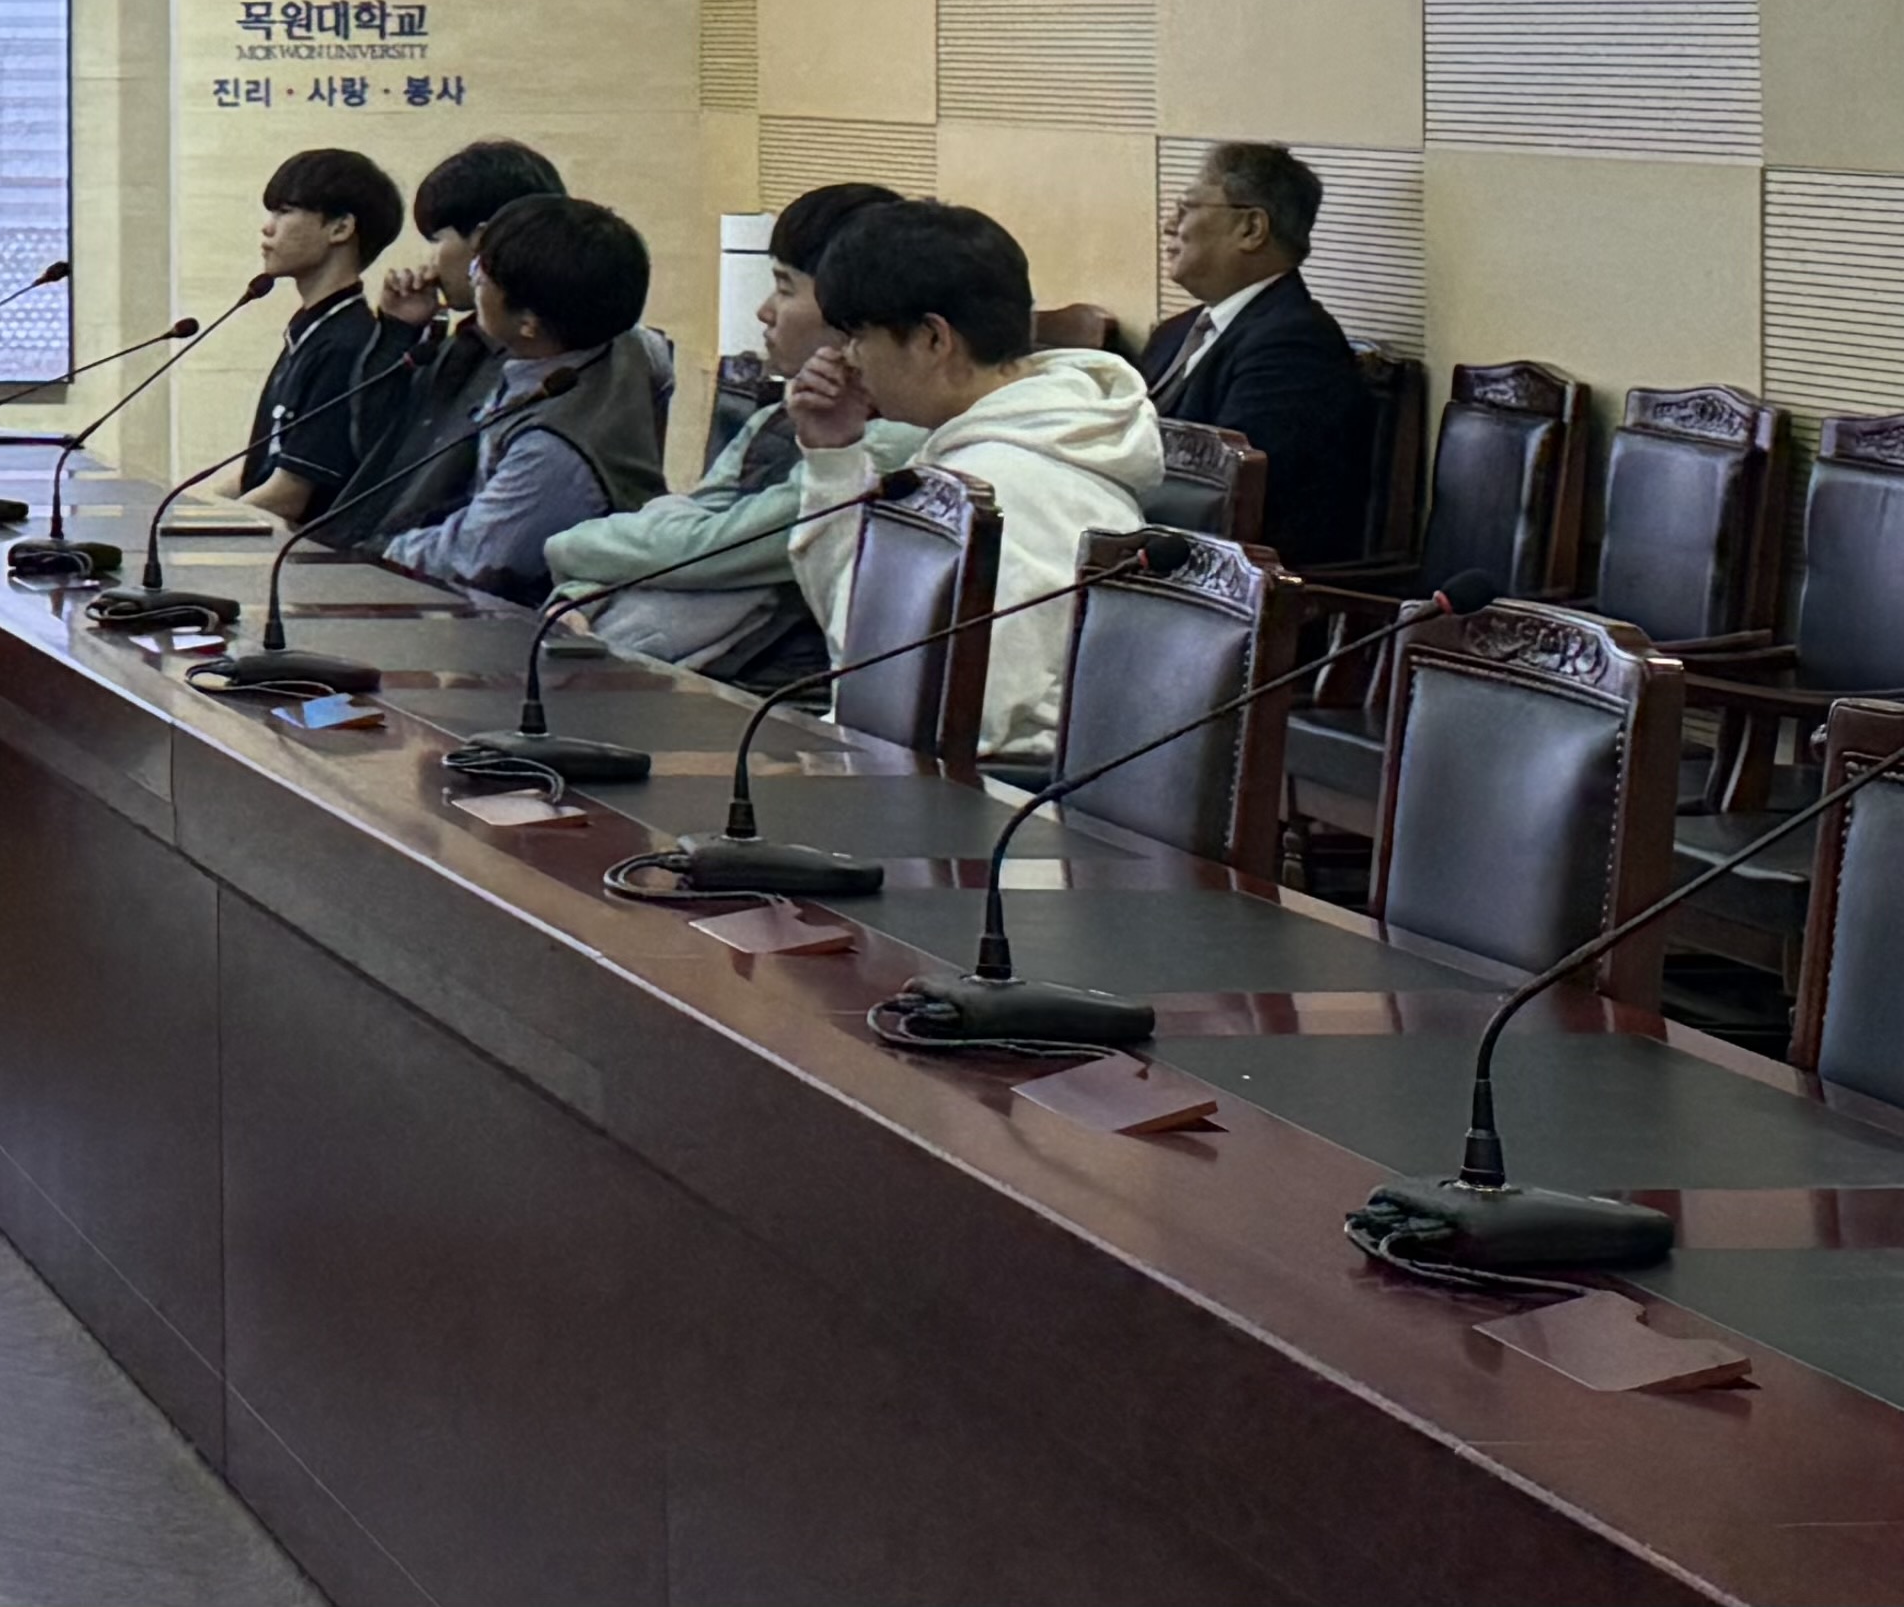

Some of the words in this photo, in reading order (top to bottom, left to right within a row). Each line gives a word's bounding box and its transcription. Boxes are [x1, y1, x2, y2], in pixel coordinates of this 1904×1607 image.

[235, 0, 429, 41] 목원대학교
[212, 75, 272, 107] 진리
[306, 75, 369, 108] 사랑
[403, 75, 467, 107] 봉사
